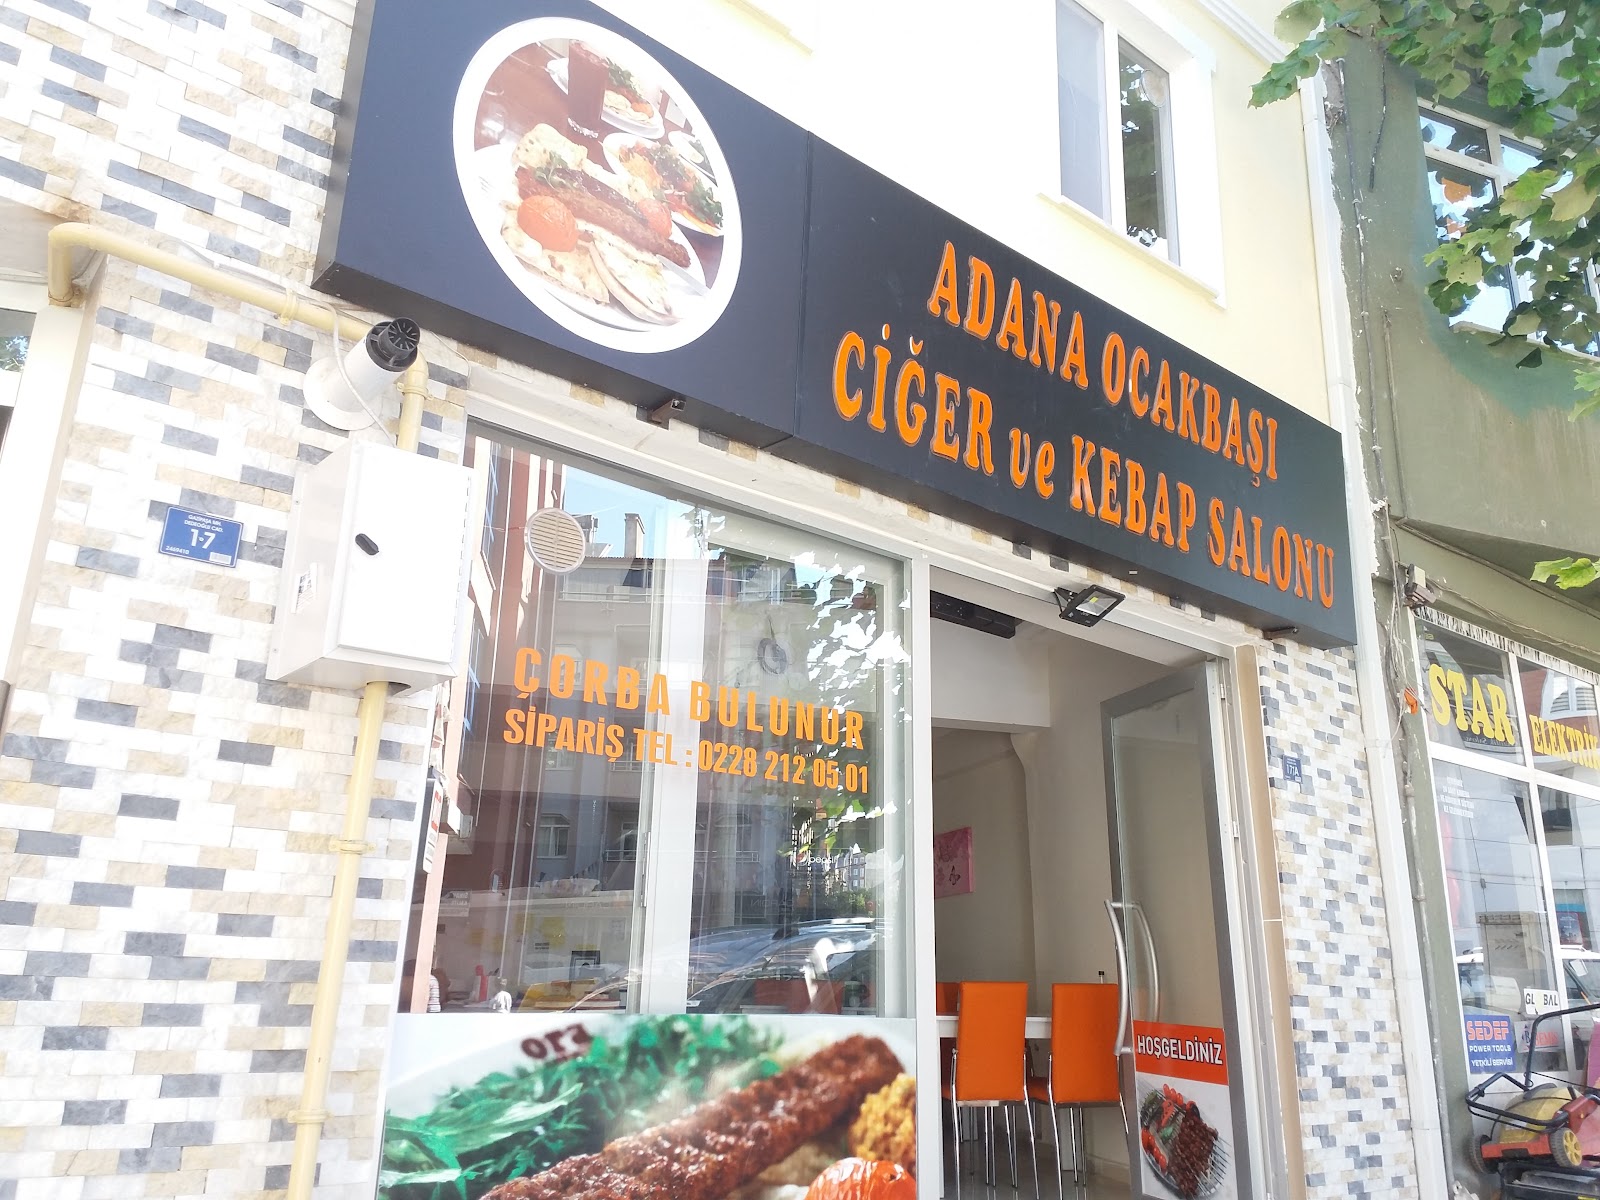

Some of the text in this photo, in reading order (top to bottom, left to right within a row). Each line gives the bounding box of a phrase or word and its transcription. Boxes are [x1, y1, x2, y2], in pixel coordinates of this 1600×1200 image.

[927, 240, 1278, 487] ADANA OCAKBAŞI
[833, 323, 1335, 609] CİĞER ve KEBAP SALONU
[191, 528, 215, 549] 17
[513, 647, 864, 750] ÇORBA BULUNUR
[1429, 663, 1516, 746] STAR
[503, 706, 625, 762] SİPARİŞ
[633, 728, 677, 765] TEL
[698, 740, 757, 778] 0228
[764, 751, 806, 784] 212
[813, 758, 839, 789] 05
[845, 764, 868, 794] 01
[1529, 714, 1600, 771] ELEKTRİK
[1137, 1034, 1223, 1065] HOŞGELDİNİZ
[1466, 1020, 1509, 1040] SEDEF
[1492, 1044, 1512, 1052] TOOLS
